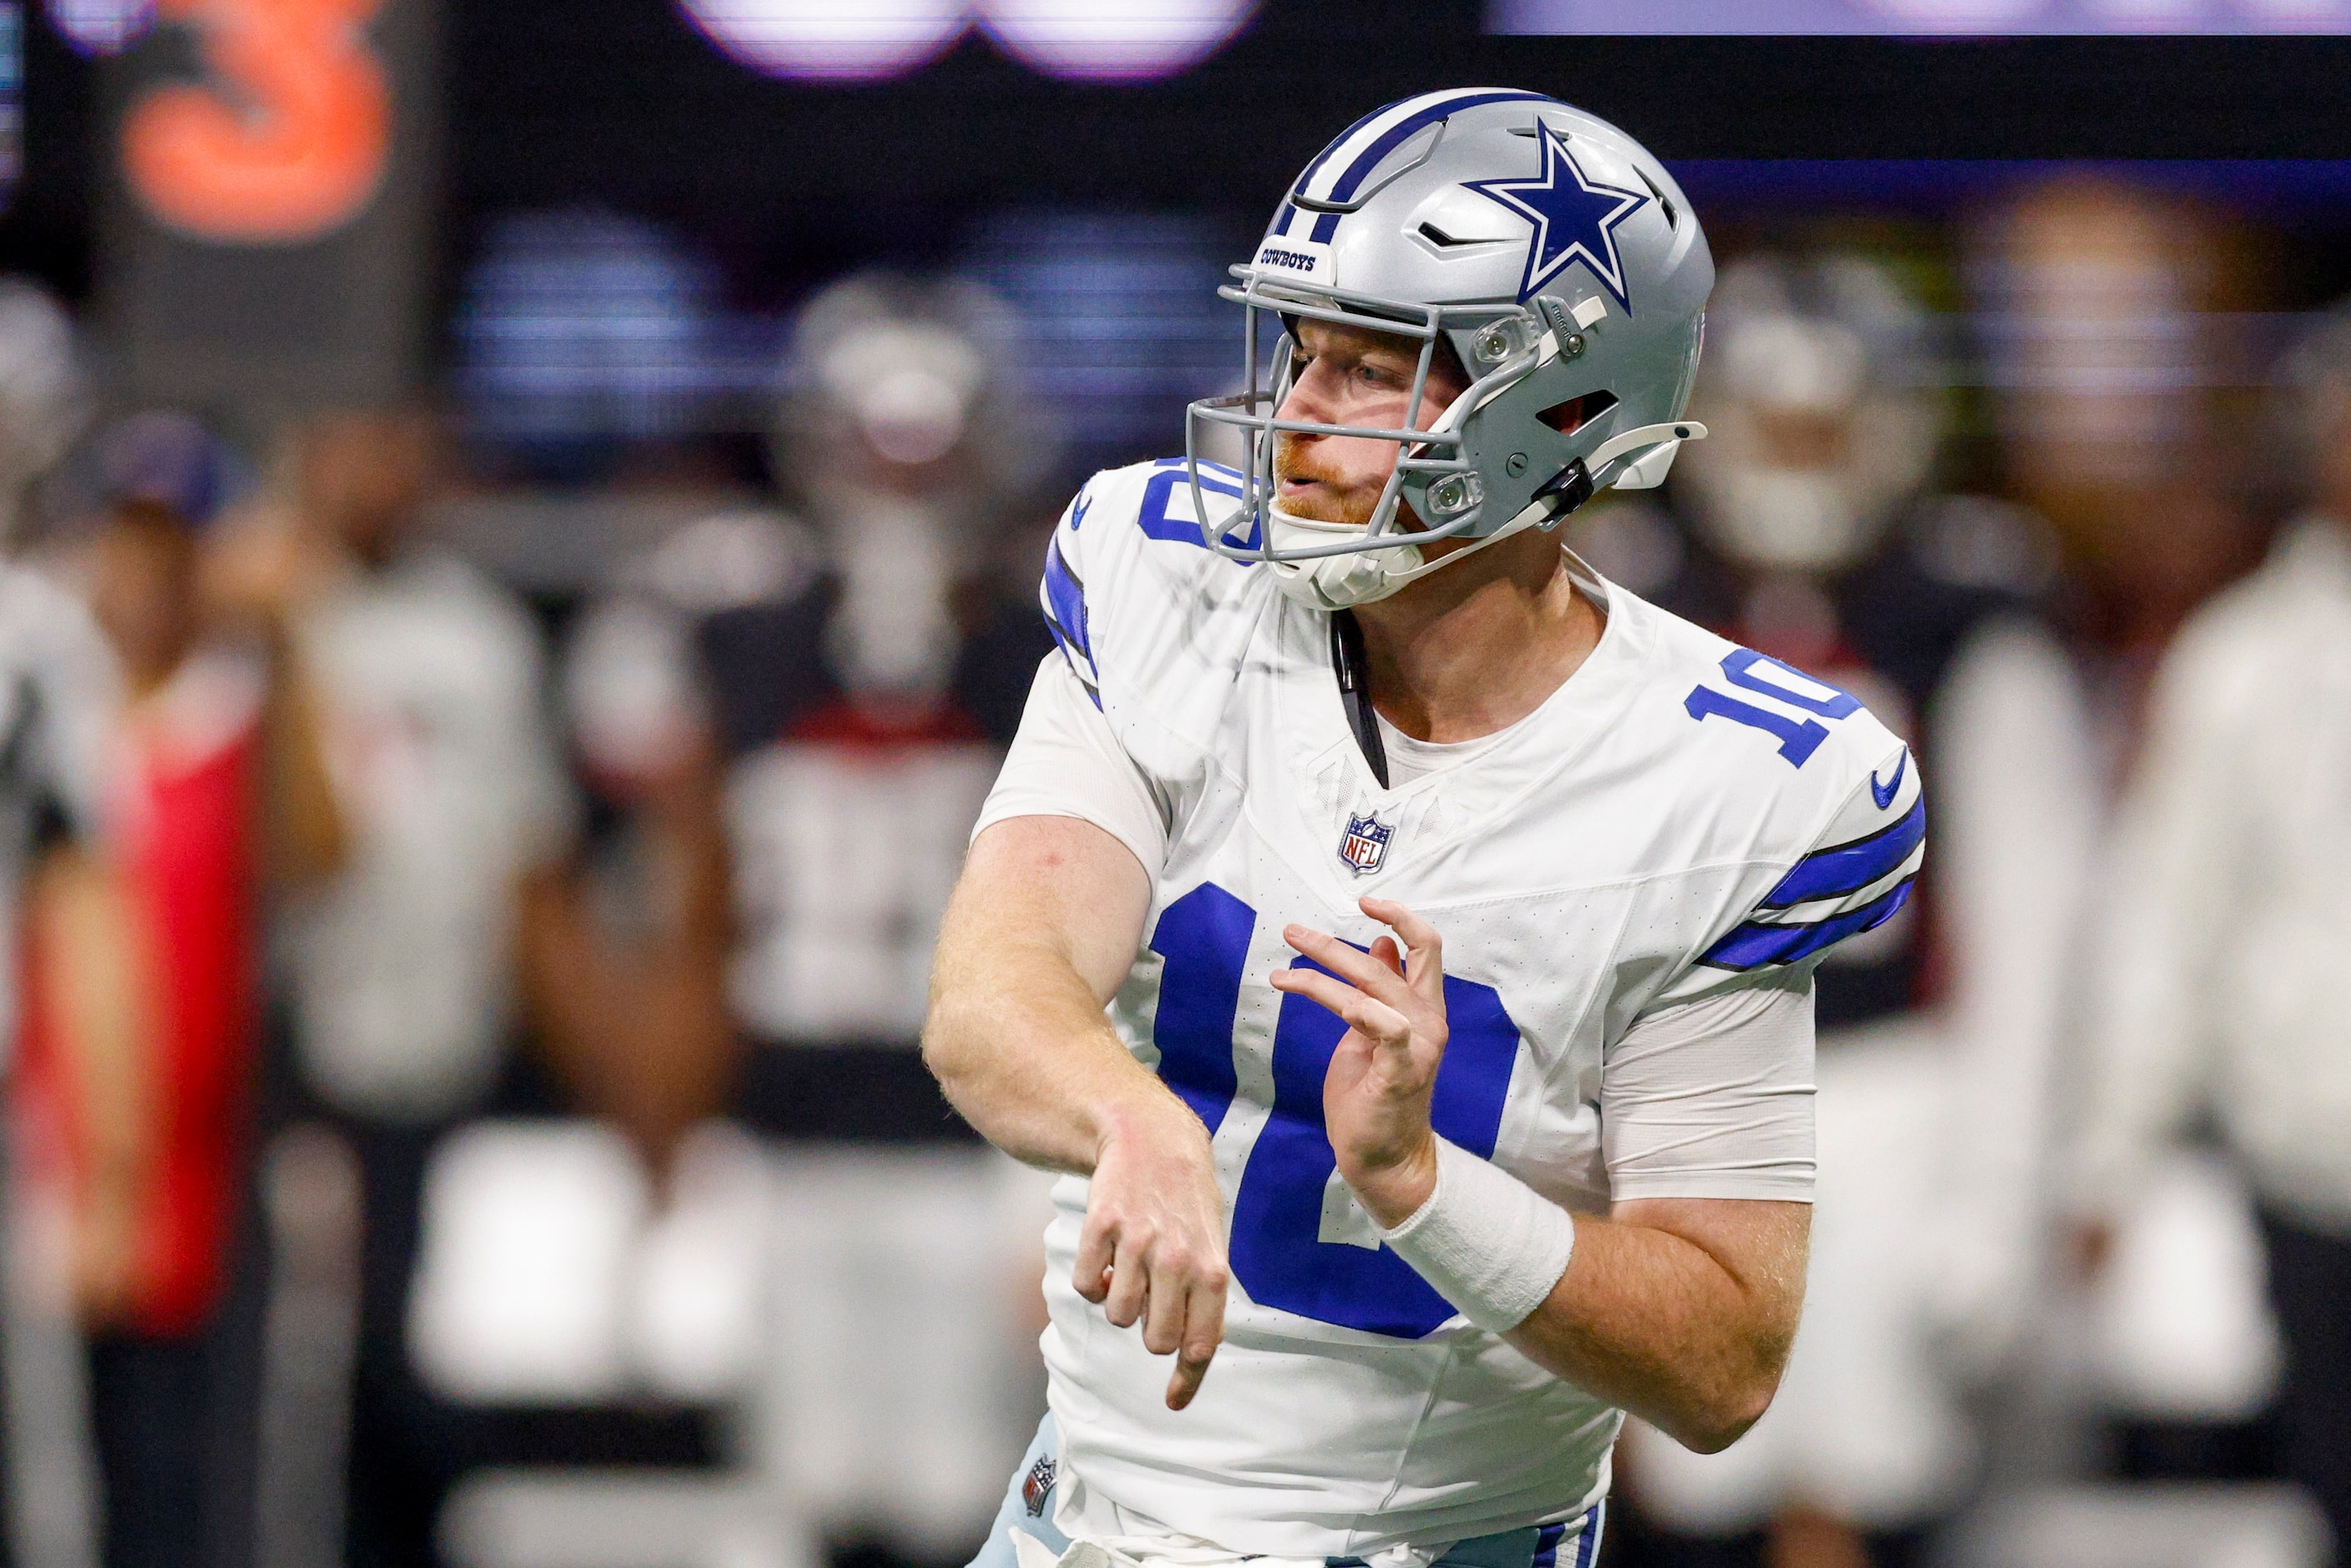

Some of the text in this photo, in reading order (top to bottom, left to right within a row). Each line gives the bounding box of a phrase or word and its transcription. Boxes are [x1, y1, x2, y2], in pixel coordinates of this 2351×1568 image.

[1261, 248, 1316, 271] COWBOYS
[1684, 647, 1864, 769] 10
[1344, 836, 1377, 865] NFL
[1148, 880, 1521, 1339] 10
